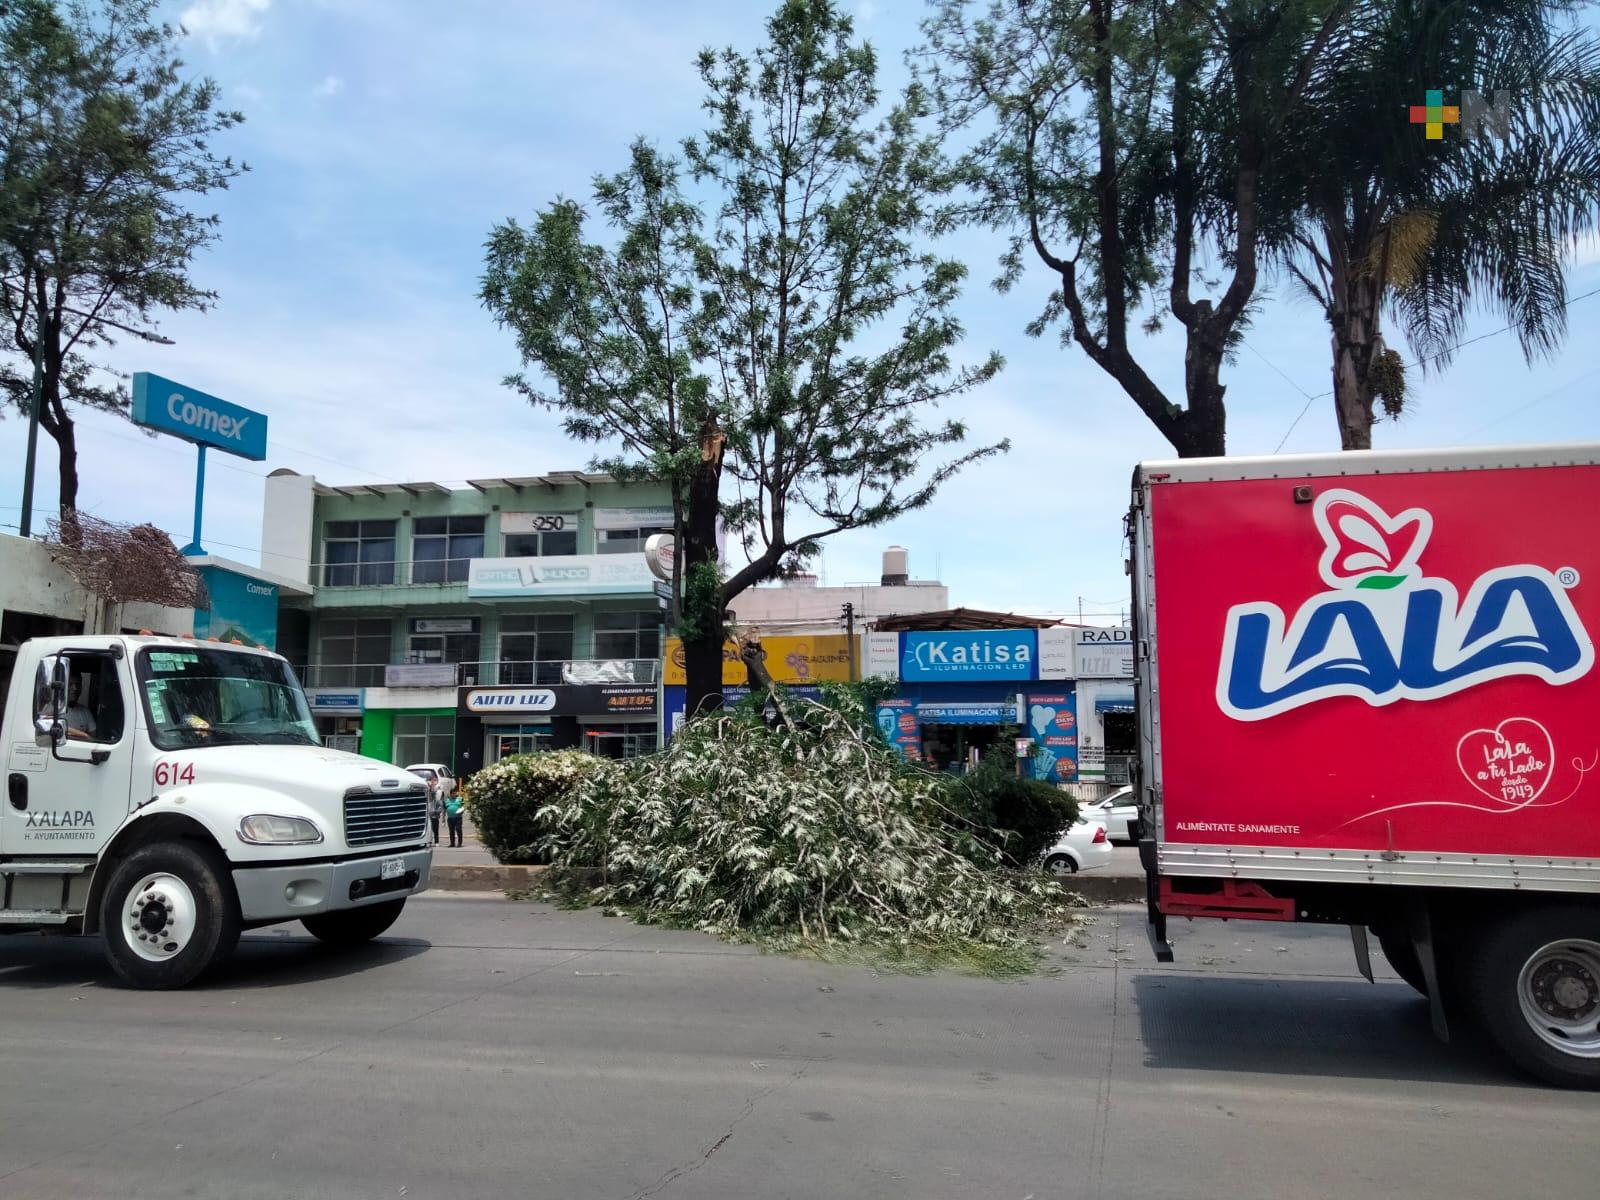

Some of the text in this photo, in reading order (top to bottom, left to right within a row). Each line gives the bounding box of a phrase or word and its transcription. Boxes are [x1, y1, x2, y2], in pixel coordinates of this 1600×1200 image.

[167, 393, 249, 440] Comex
[532, 515, 564, 531] $250
[246, 582, 274, 596] Comex
[1224, 572, 1586, 714] LALA
[928, 641, 1031, 663] Katisa
[934, 663, 1001, 671] ILUMINACION
[473, 694, 550, 705] AUTO LUZ
[607, 695, 656, 706] AUTOS
[918, 708, 946, 717] KATISA
[154, 762, 195, 786] 614
[1477, 770, 1489, 780] a
[1488, 762, 1507, 779] tu
[1501, 775, 1528, 787] desde
[1501, 784, 1534, 800] 1949
[26, 810, 96, 828] XALAPA
[24, 831, 96, 841] H. AYUNTAMIENTO
[1238, 823, 1300, 834] SANAMENTE
